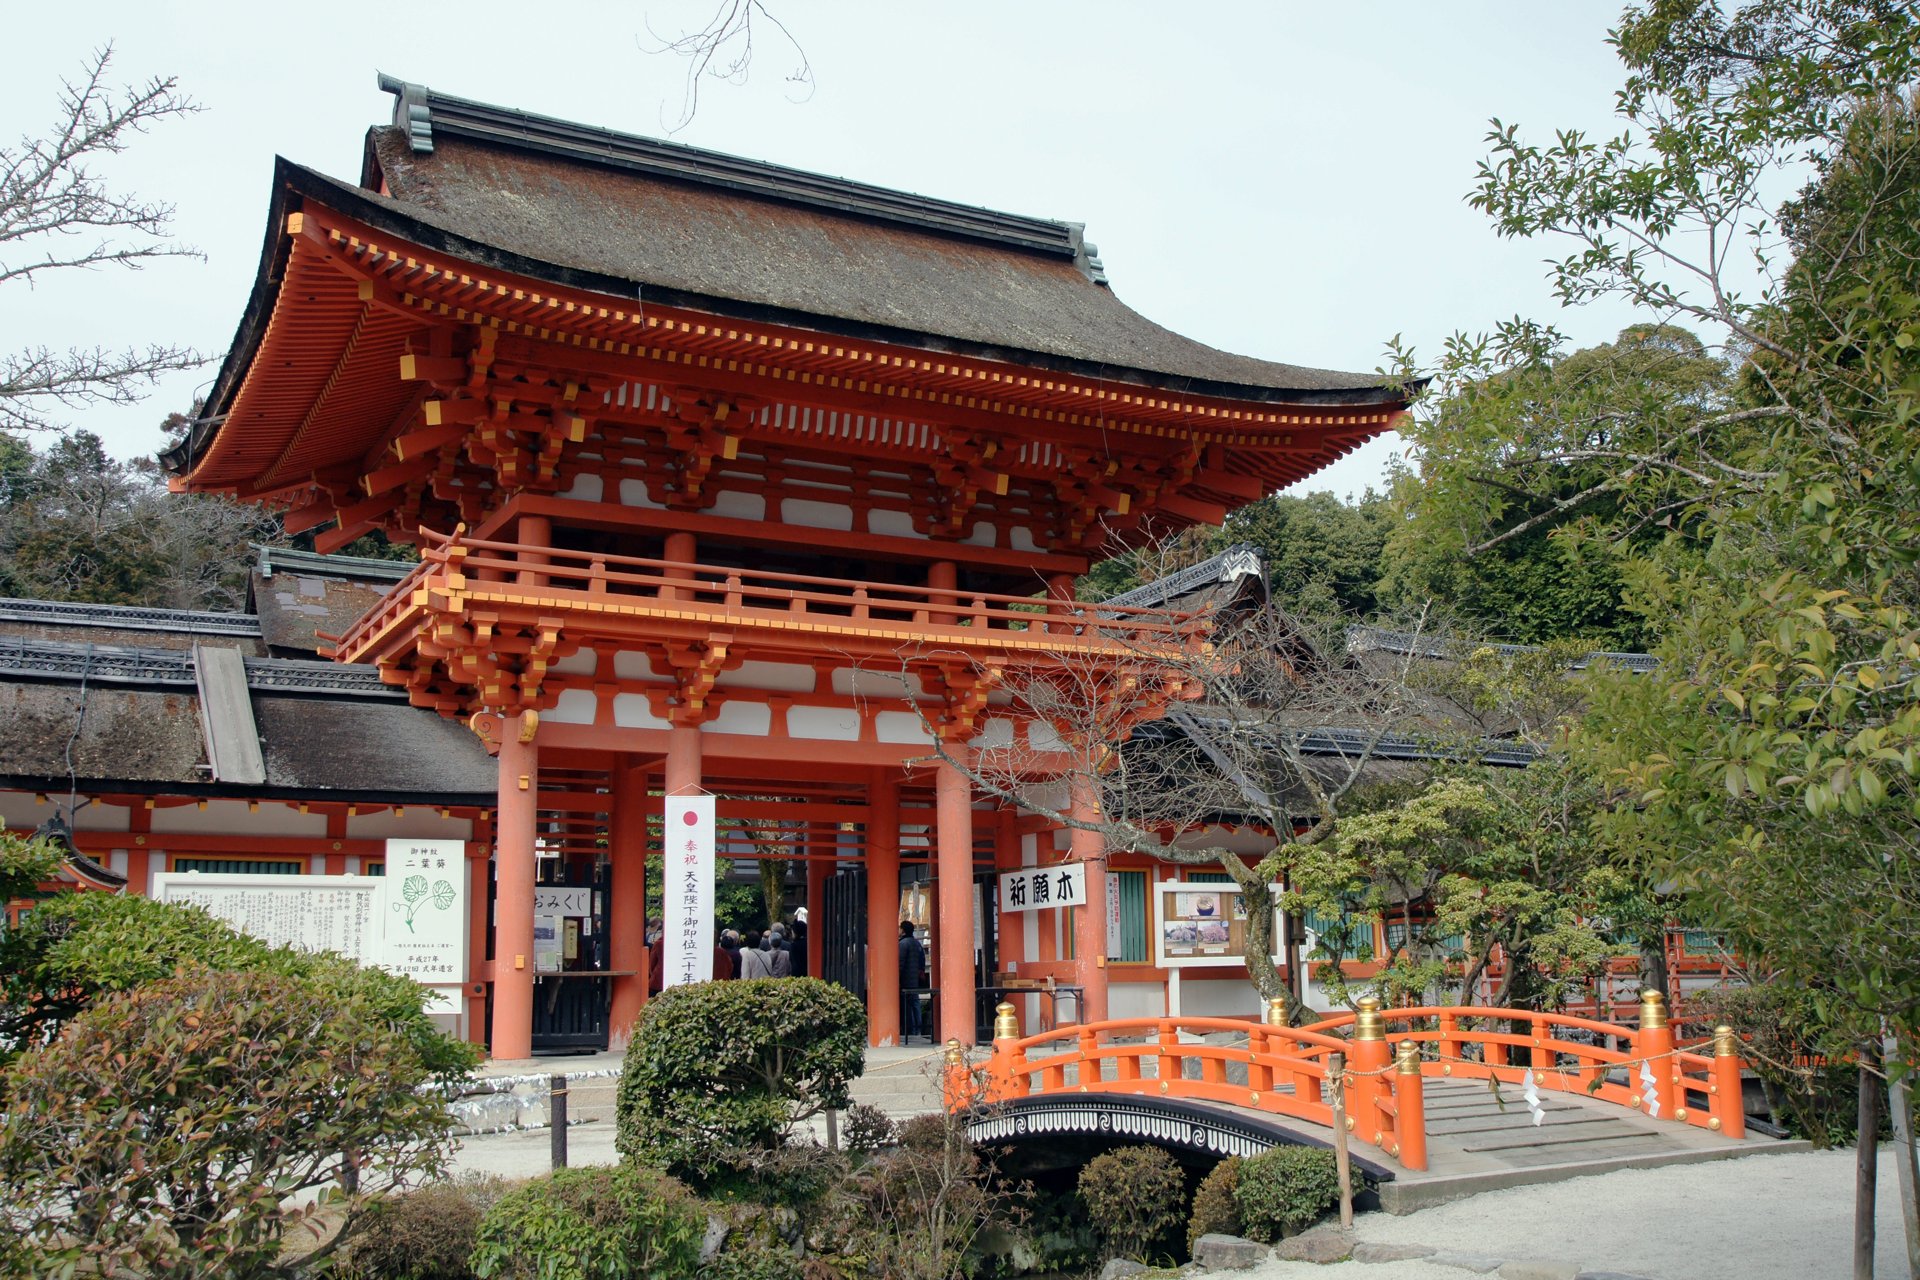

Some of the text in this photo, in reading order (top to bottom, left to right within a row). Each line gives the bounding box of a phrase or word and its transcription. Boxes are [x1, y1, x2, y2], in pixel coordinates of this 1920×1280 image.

[405, 858, 445, 869] 二葉葵
[1010, 871, 1073, 907] 祈願木
[534, 893, 586, 911] おみくじ
[682, 839, 698, 984] 奉祝 天皇陛下御即位二十年
[408, 955, 438, 963] 平成27年
[423, 965, 453, 973] 式年遷宮
